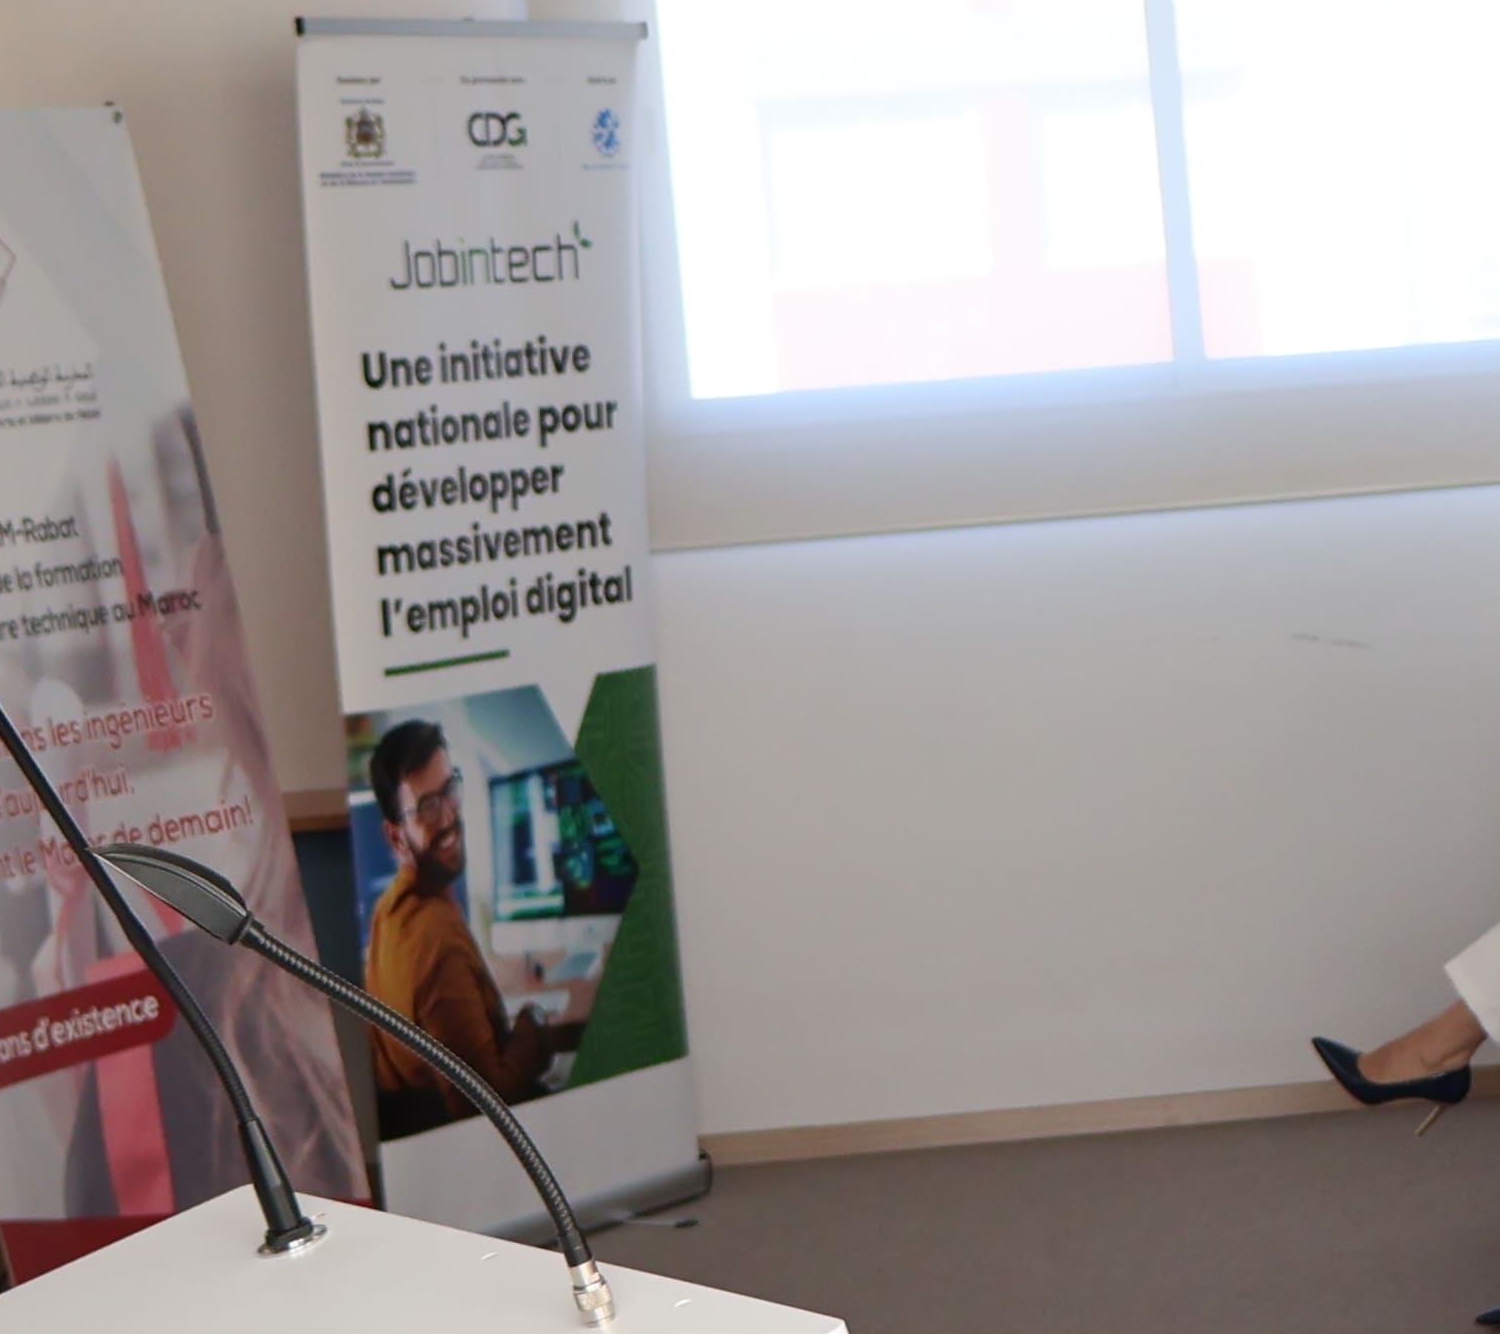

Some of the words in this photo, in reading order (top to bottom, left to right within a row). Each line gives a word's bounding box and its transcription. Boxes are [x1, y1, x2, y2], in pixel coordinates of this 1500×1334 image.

[467, 112, 528, 148] CDG
[389, 231, 580, 290] Jobintech
[361, 351, 432, 389] Une
[439, 334, 591, 383] initiative
[367, 400, 531, 452] nationale
[537, 400, 618, 448] pour
[371, 464, 565, 514] développer
[377, 512, 613, 576] massivement
[15, 566, 34, 591] la
[34, 557, 124, 587] formation
[21, 605, 110, 638] technique
[113, 600, 136, 620] au
[137, 587, 203, 617] Maroc
[380, 577, 519, 638] l'emploi
[526, 565, 633, 623] digital
[49, 717, 82, 748] les
[17, 847, 37, 876] le
[38, 832, 106, 871] Mac
[113, 821, 142, 845] de
[148, 794, 254, 846] demain!
